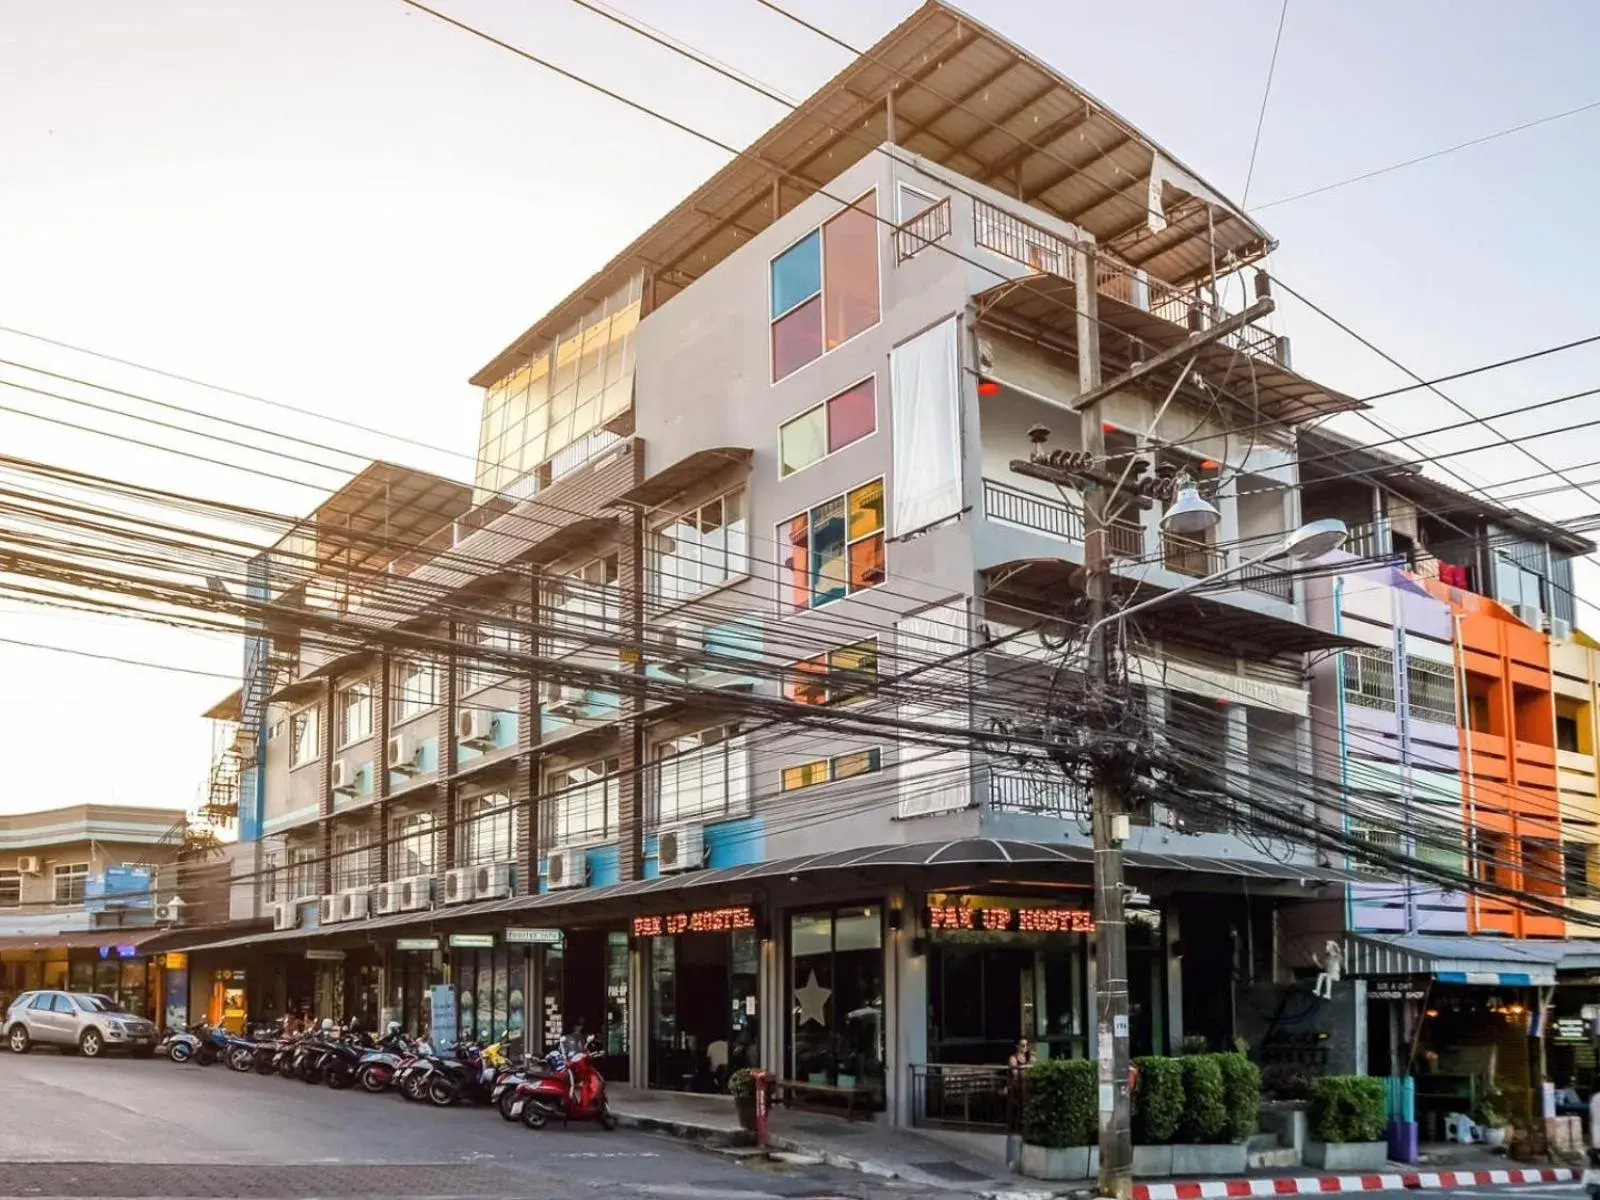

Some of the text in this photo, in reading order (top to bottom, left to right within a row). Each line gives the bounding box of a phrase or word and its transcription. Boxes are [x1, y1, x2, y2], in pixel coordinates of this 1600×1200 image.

[633, 907, 754, 936] PAK UP HOSTEL
[930, 907, 1096, 932] PAK UP HOSTEL
